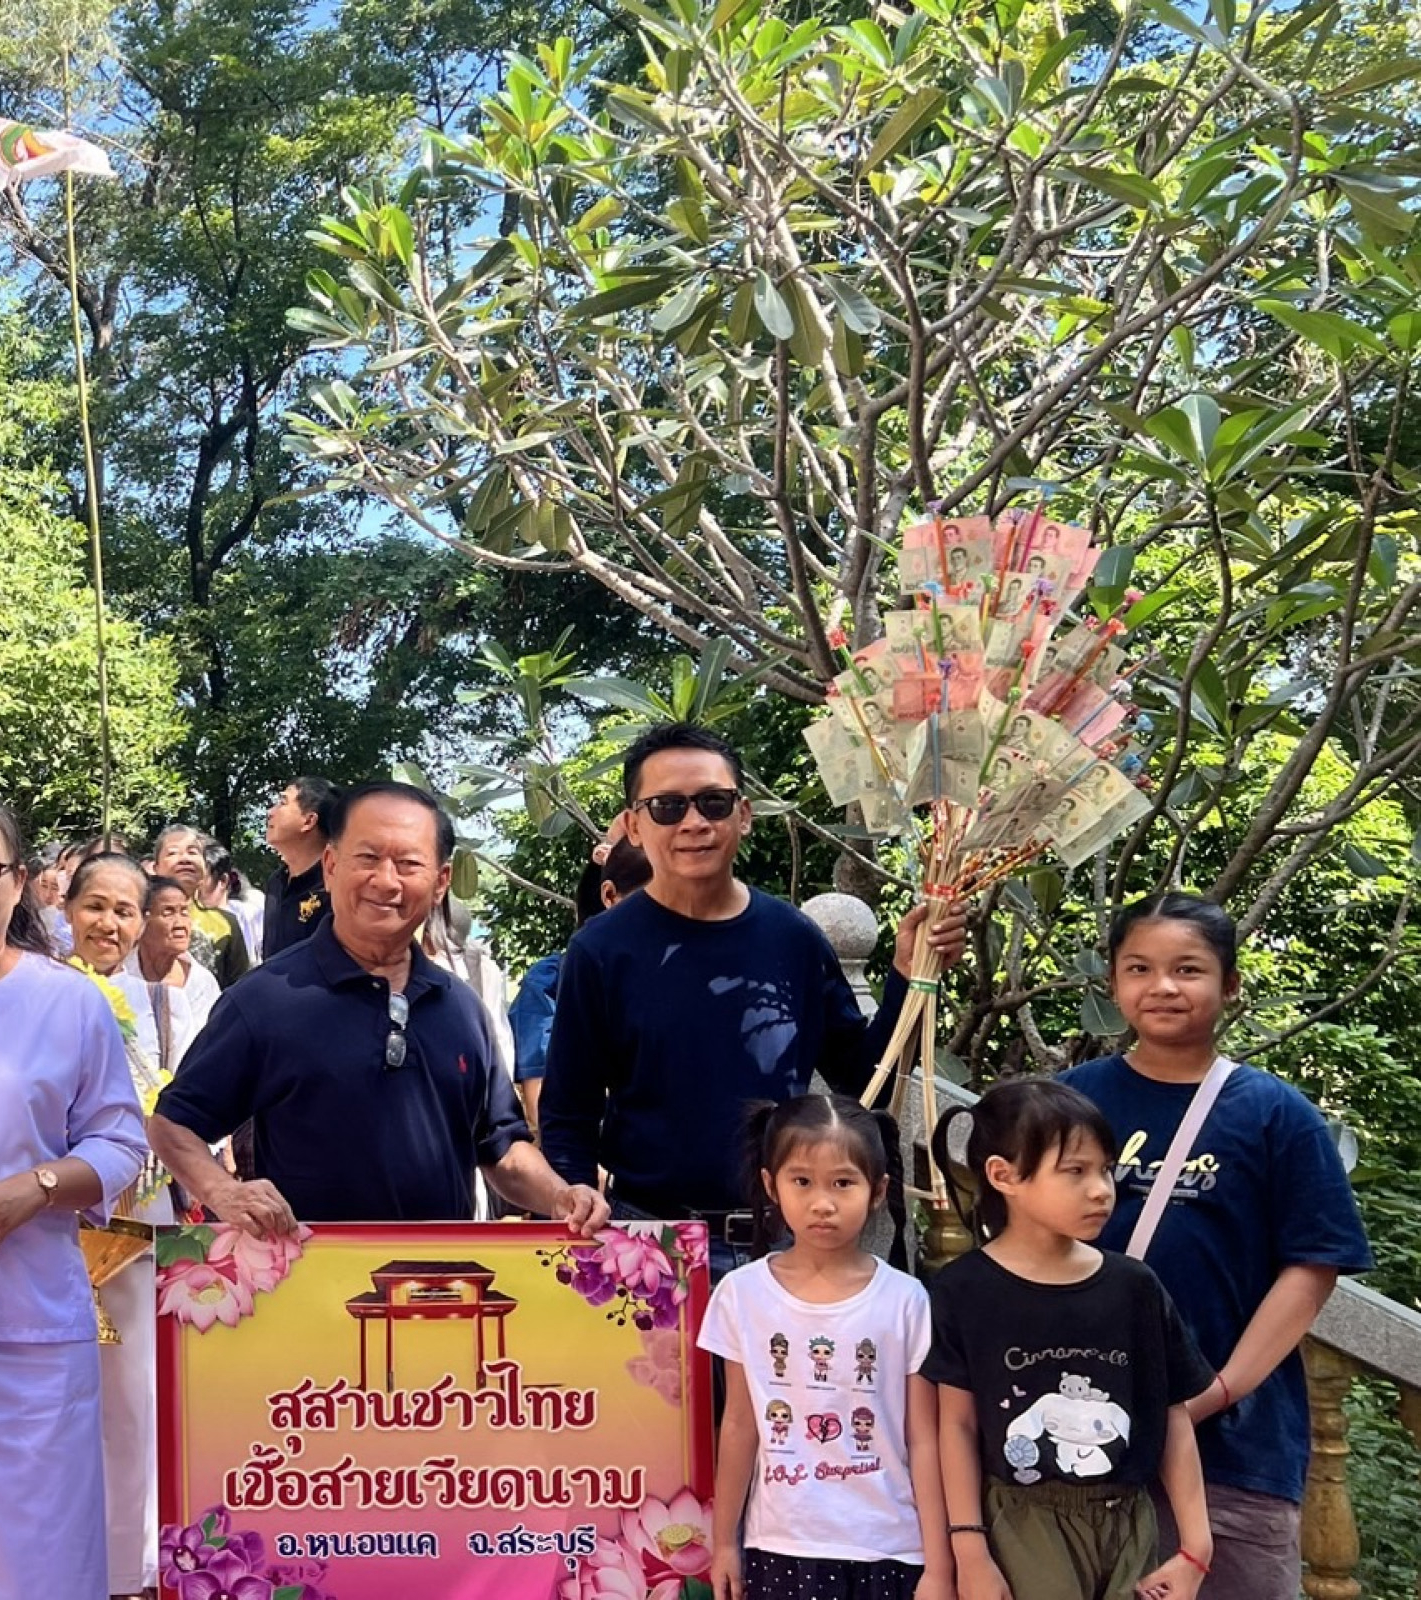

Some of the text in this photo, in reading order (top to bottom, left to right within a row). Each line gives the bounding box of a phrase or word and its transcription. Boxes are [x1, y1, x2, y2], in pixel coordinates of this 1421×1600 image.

[268, 1360, 596, 1456] สุสานชาวไทย
[224, 1444, 644, 1509] เชื้อสายเวียดนาม
[277, 1524, 596, 1570] อ.หนองแค จ.สระบุรี
